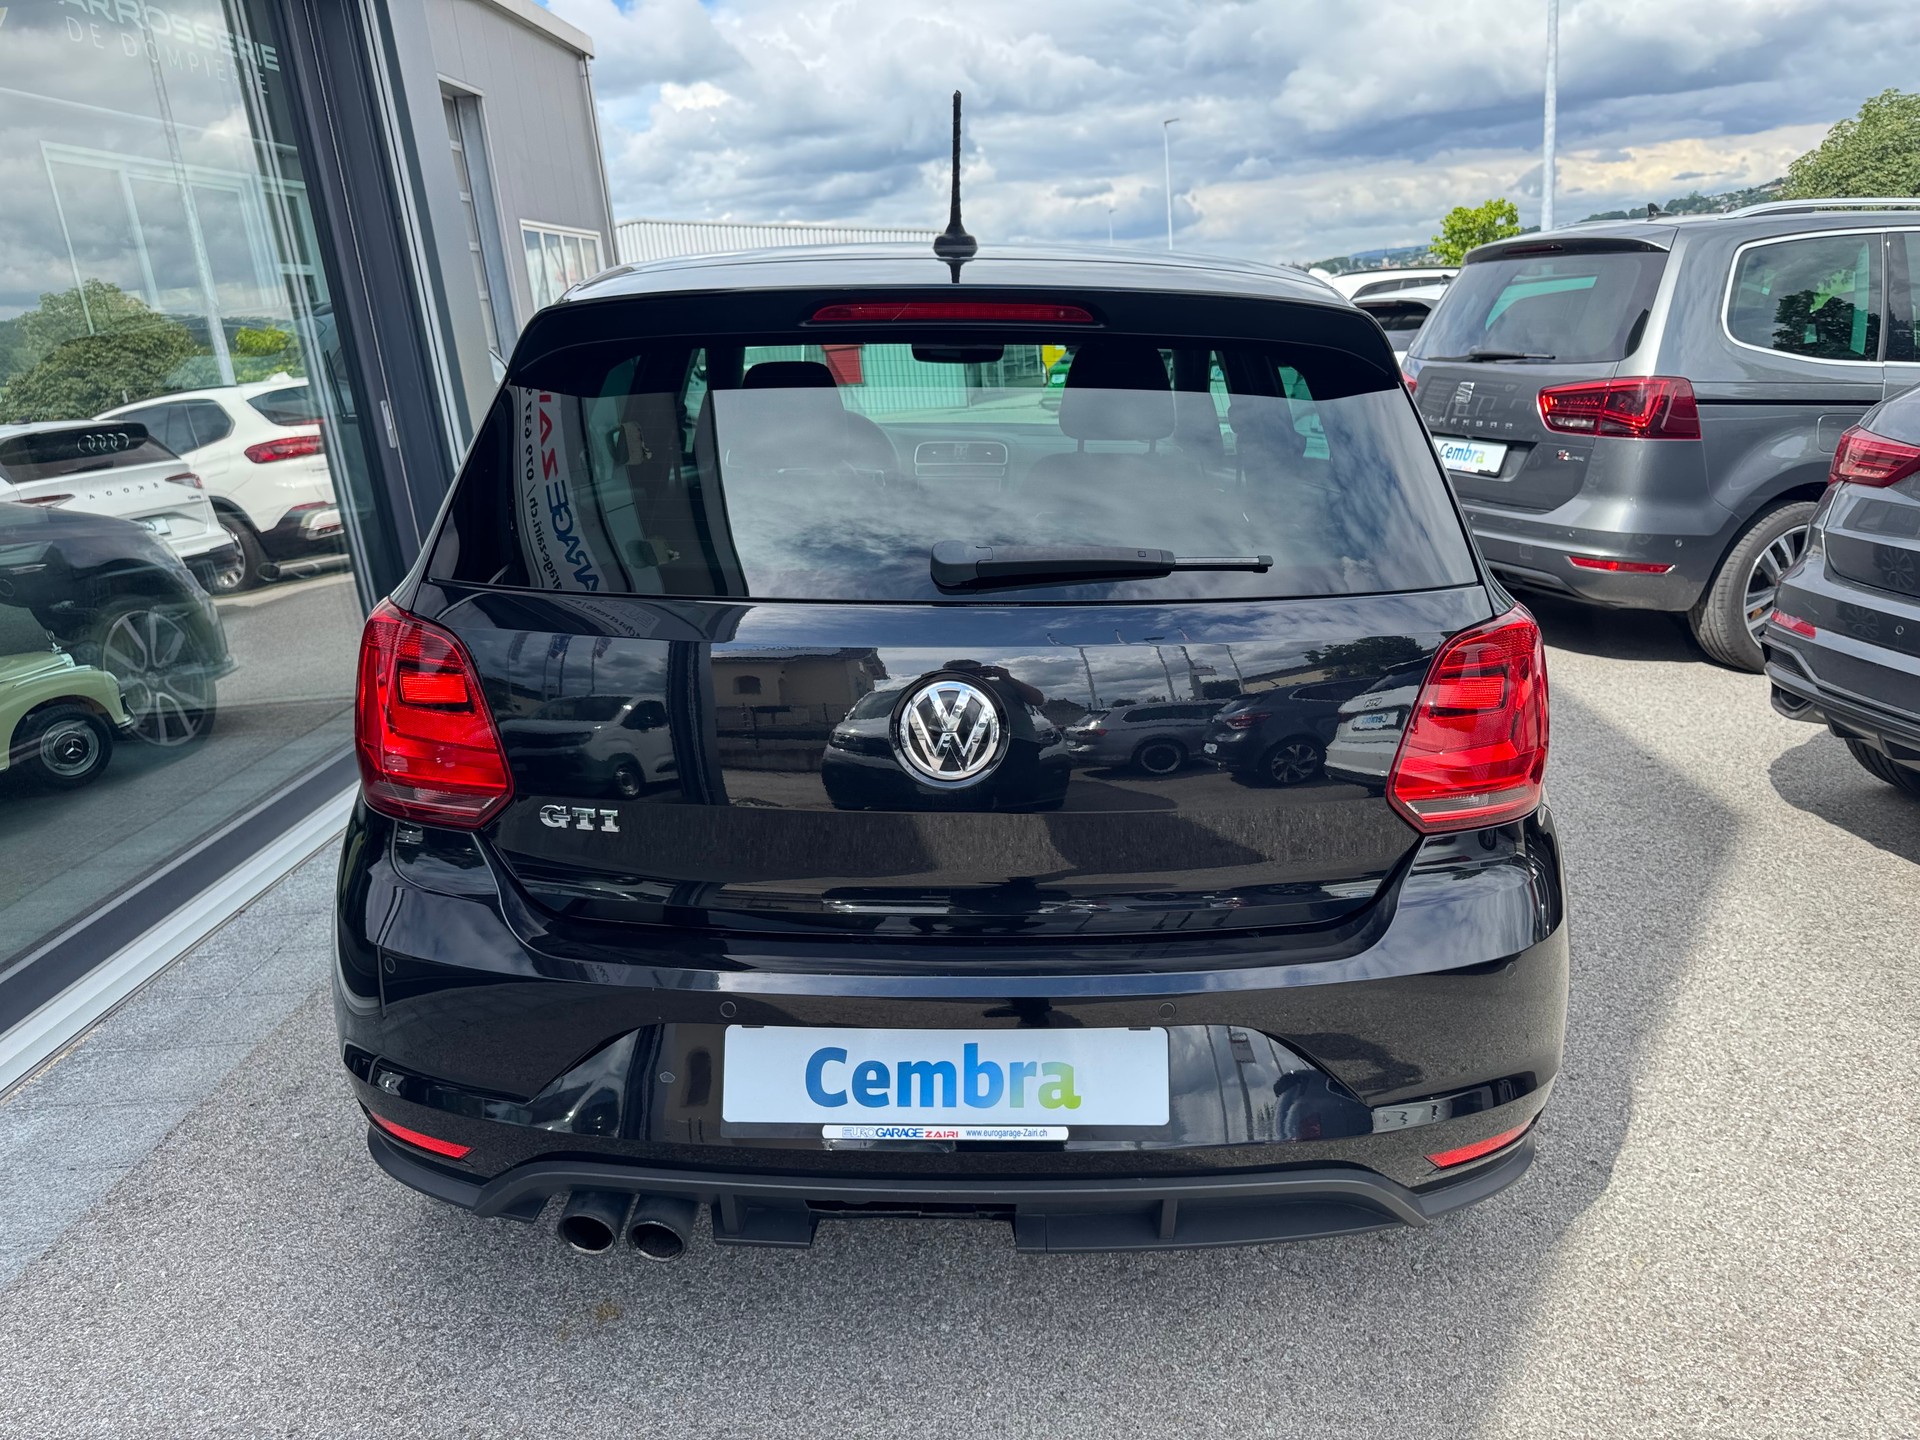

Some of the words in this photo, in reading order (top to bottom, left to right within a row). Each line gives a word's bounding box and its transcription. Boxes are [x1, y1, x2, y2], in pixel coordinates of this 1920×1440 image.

[66, 15, 105, 49] DE
[1439, 441, 1486, 464] Cembra
[540, 804, 620, 832] GTI
[804, 1042, 1082, 1110] Cembra
[965, 1128, 1048, 1139] www.eurogarage-Zairi.ch
